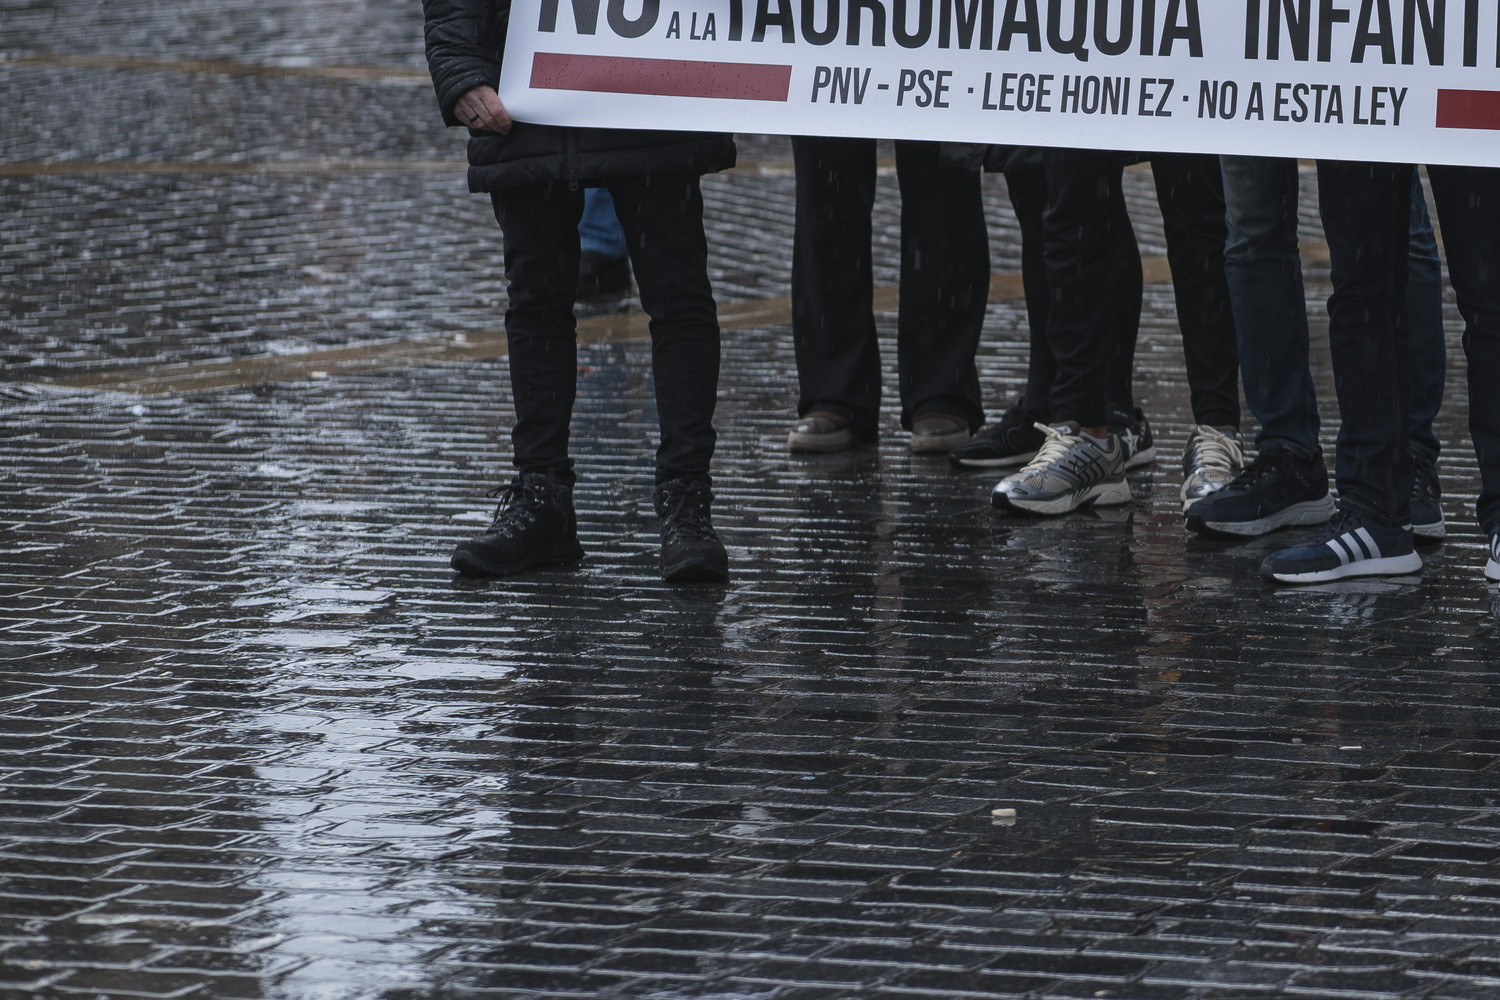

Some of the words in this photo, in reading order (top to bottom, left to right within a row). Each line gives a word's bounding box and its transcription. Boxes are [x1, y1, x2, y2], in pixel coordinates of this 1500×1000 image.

[665, 10, 682, 41] A
[688, 11, 717, 42] LA
[810, 65, 872, 105] PNV
[896, 68, 953, 109] PSE
[981, 72, 1055, 113] LEGE
[1060, 74, 1131, 116] HONI
[1137, 77, 1175, 118] EZ
[1197, 79, 1238, 120] NO
[1244, 81, 1266, 121] A
[1273, 82, 1344, 124] ESTA
[1352, 85, 1409, 127] LEY
